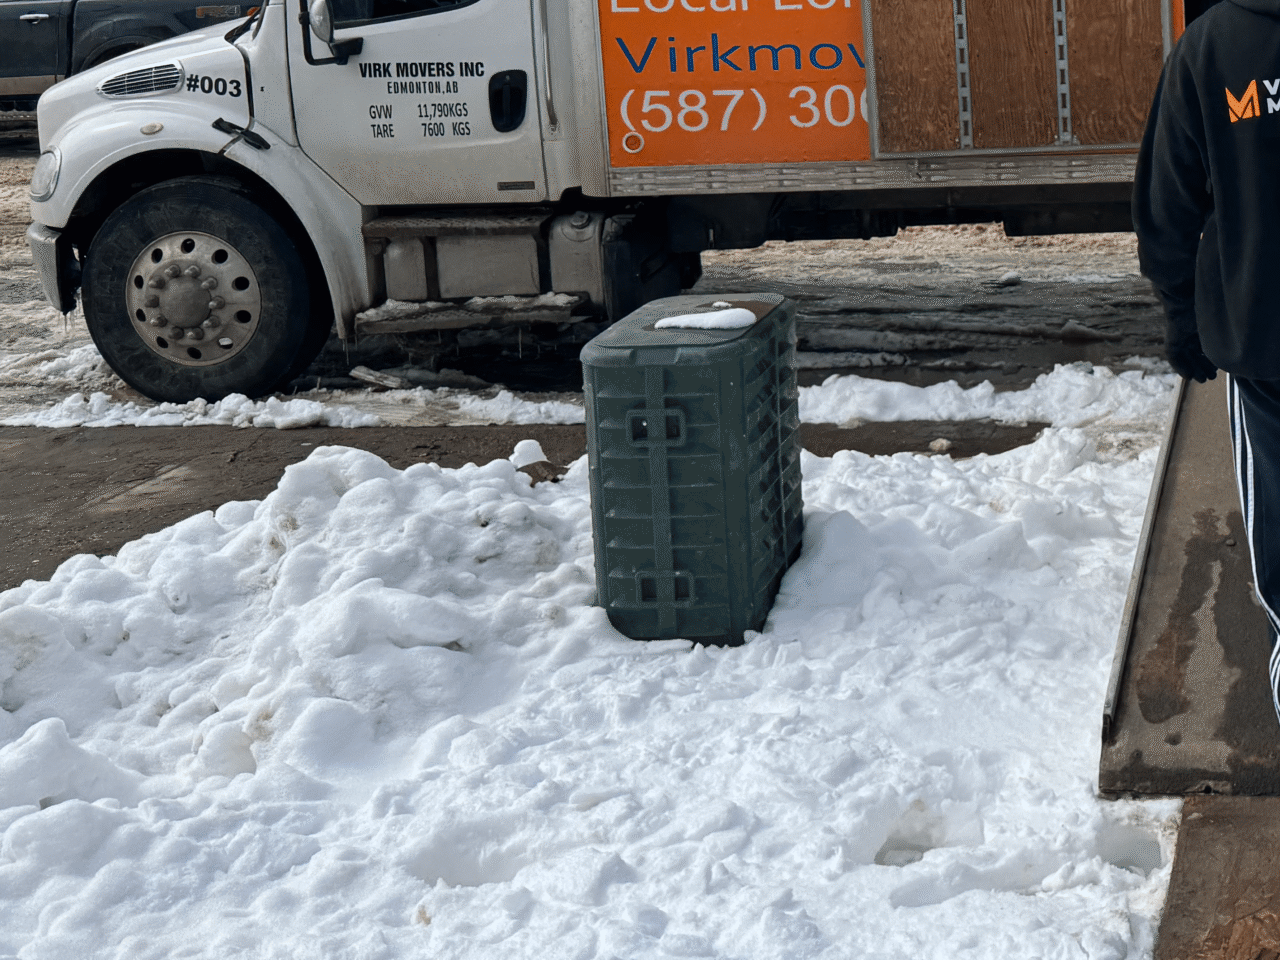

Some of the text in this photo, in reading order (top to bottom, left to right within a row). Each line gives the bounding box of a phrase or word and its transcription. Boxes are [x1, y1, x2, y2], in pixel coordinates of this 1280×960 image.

[359, 62, 485, 78] VIRK MOVERS INC
[186, 74, 242, 97] #003
[387, 81, 459, 94] EDMONTON,AB
[369, 102, 469, 120] GVW 11,790KGS
[620, 89, 767, 131] (587)
[371, 121, 471, 138] TARE 7600 KGS
